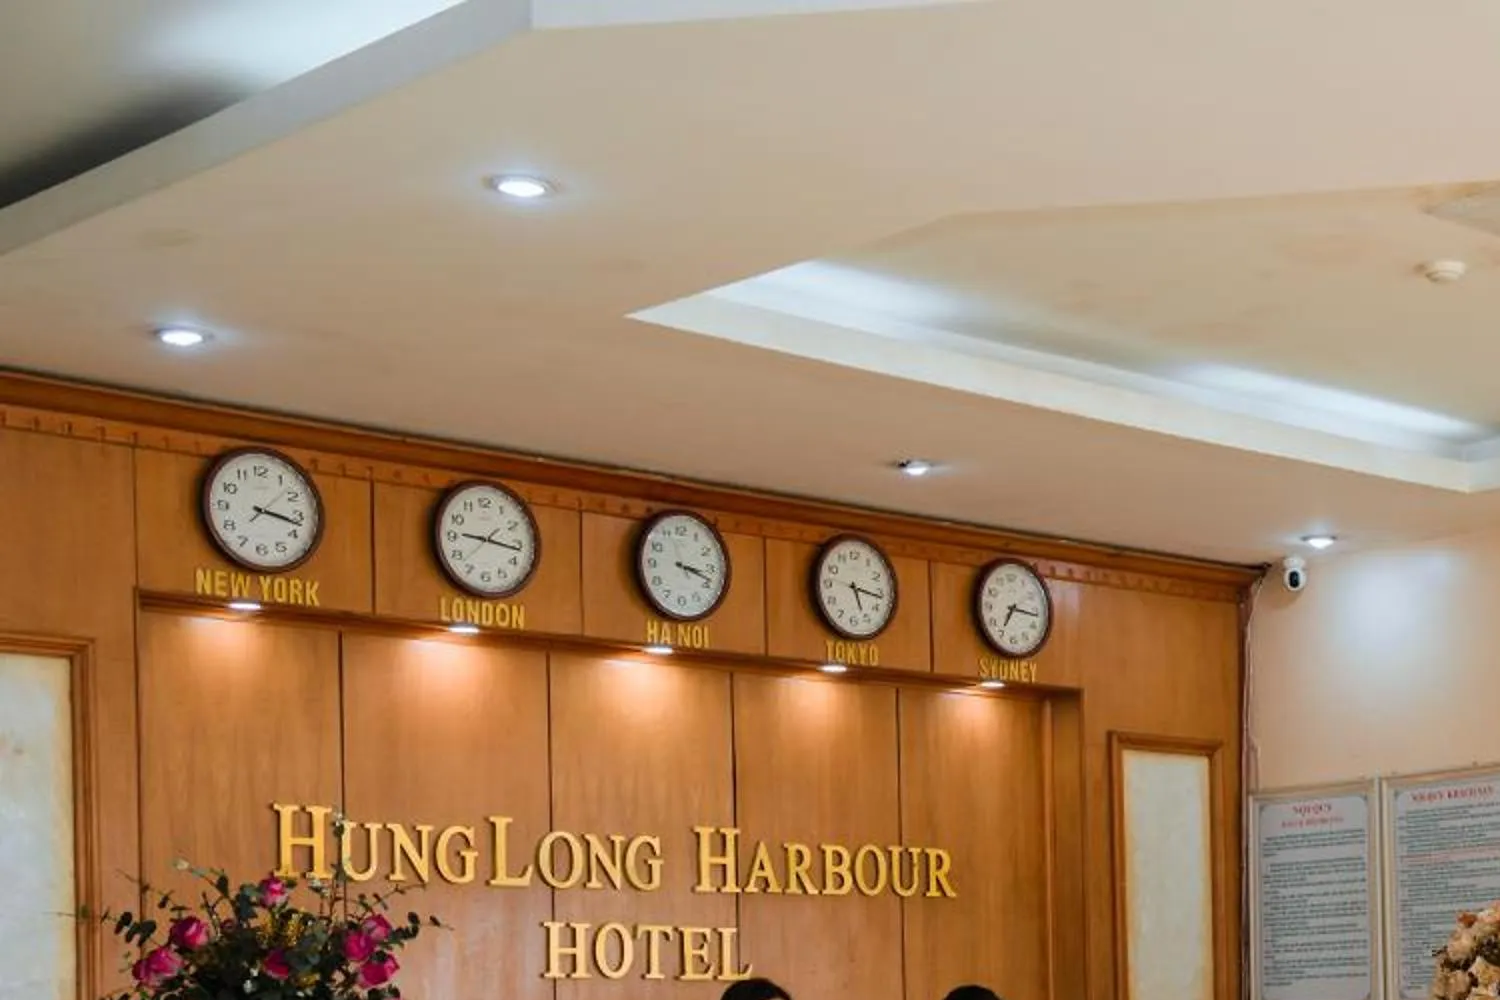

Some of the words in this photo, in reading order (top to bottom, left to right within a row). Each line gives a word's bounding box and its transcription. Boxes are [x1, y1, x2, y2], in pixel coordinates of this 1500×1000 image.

[196, 568, 249, 597] NEW
[259, 576, 319, 606] YORK
[440, 597, 525, 629] LONDON
[826, 640, 879, 666] TOKYO
[979, 657, 1036, 683] SYDNEY
[693, 826, 957, 898] HARBOUR
[542, 921, 753, 981] HOTEL
